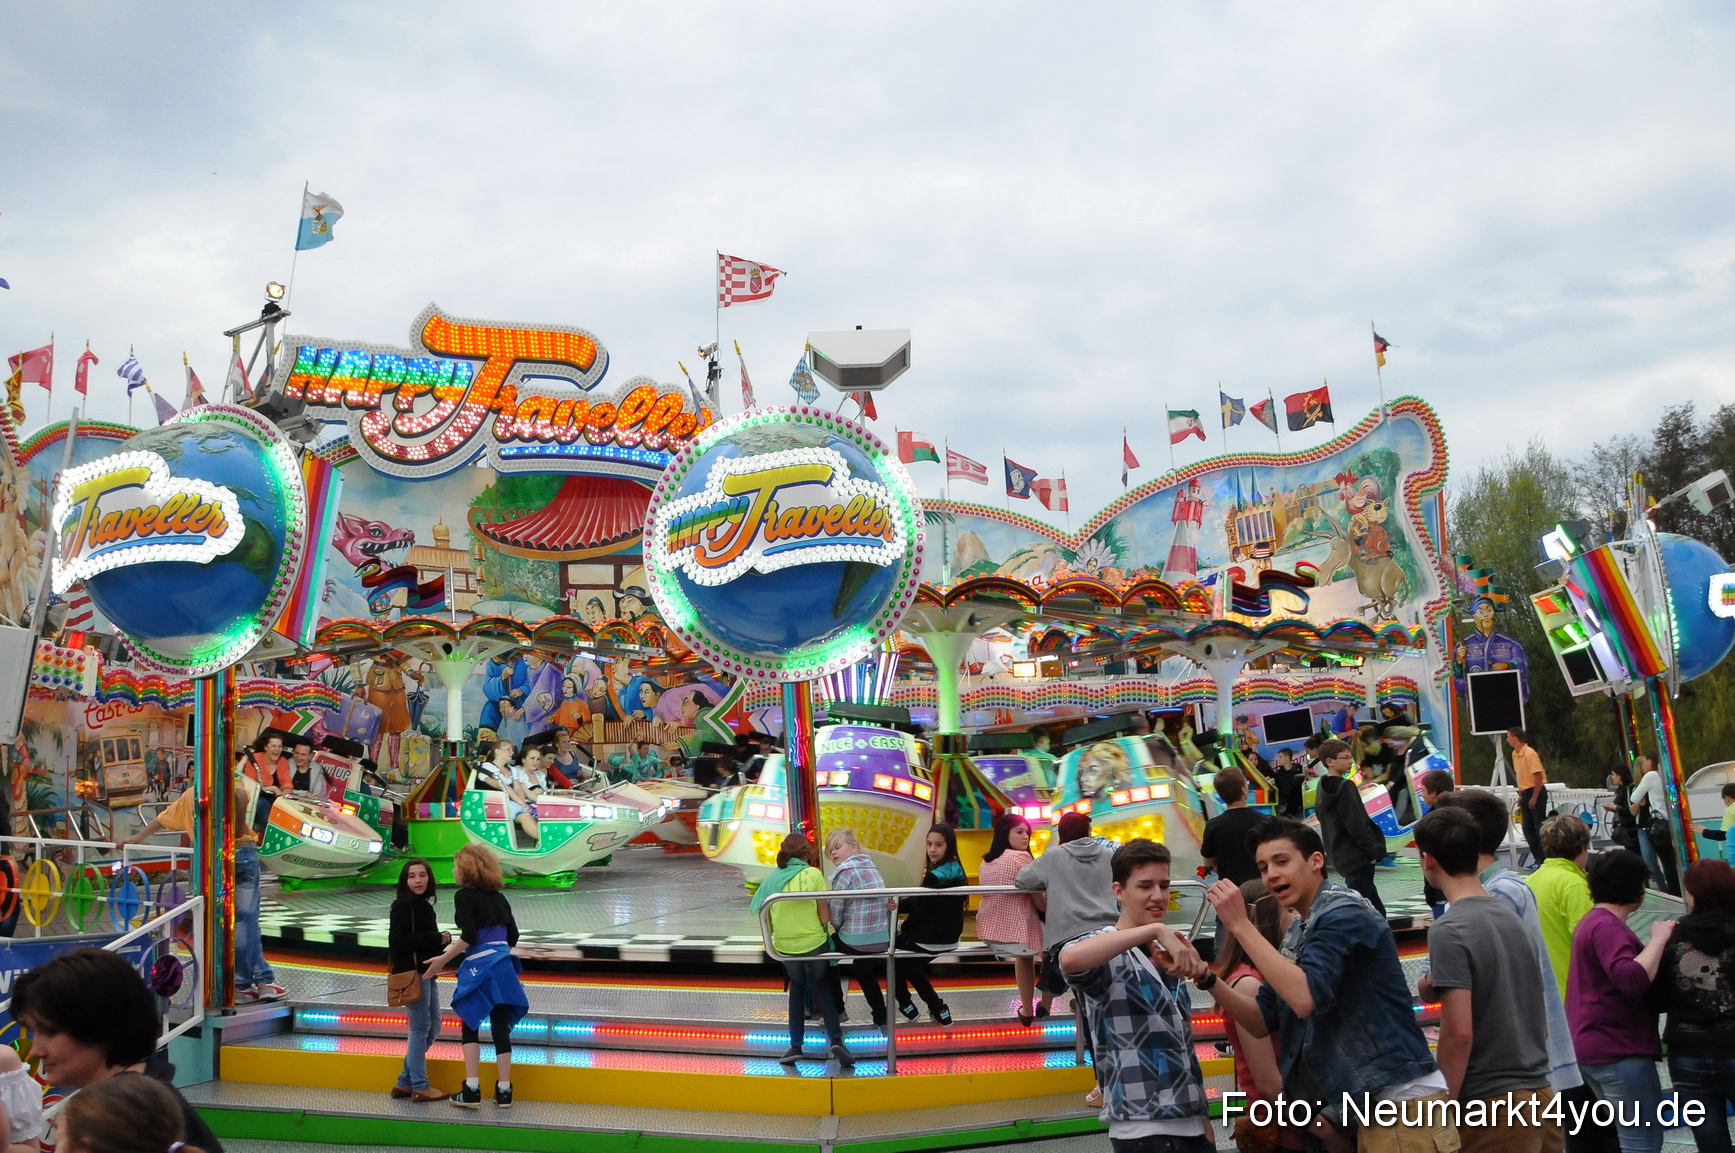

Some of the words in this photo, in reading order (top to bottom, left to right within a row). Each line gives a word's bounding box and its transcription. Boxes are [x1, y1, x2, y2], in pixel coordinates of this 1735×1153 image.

[286, 344, 474, 434] HAPPY
[63, 467, 229, 563] Traveller
[667, 497, 750, 553] HAPPY
[694, 463, 896, 568] Traveller
[335, 766, 353, 780] UP
[821, 738, 852, 753] NICE
[871, 737, 905, 751] EASY
